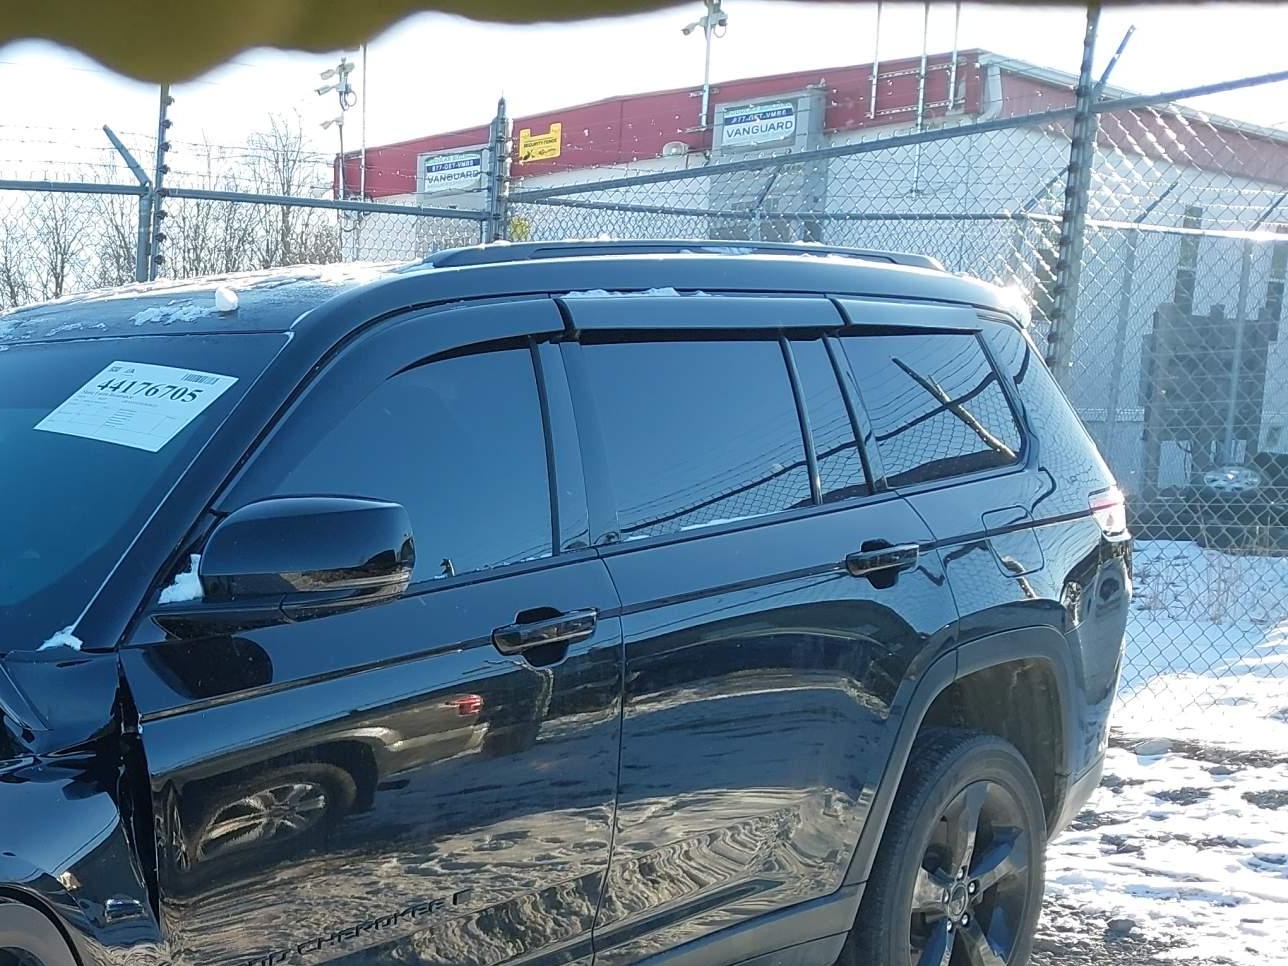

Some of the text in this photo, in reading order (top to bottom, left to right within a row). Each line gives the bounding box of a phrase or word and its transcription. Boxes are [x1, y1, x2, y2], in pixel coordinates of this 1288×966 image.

[726, 120, 793, 138] VANGUARD
[427, 169, 480, 184] VANGUARD
[97, 377, 203, 403] 44176705
[296, 896, 447, 956] CHEROKEE
